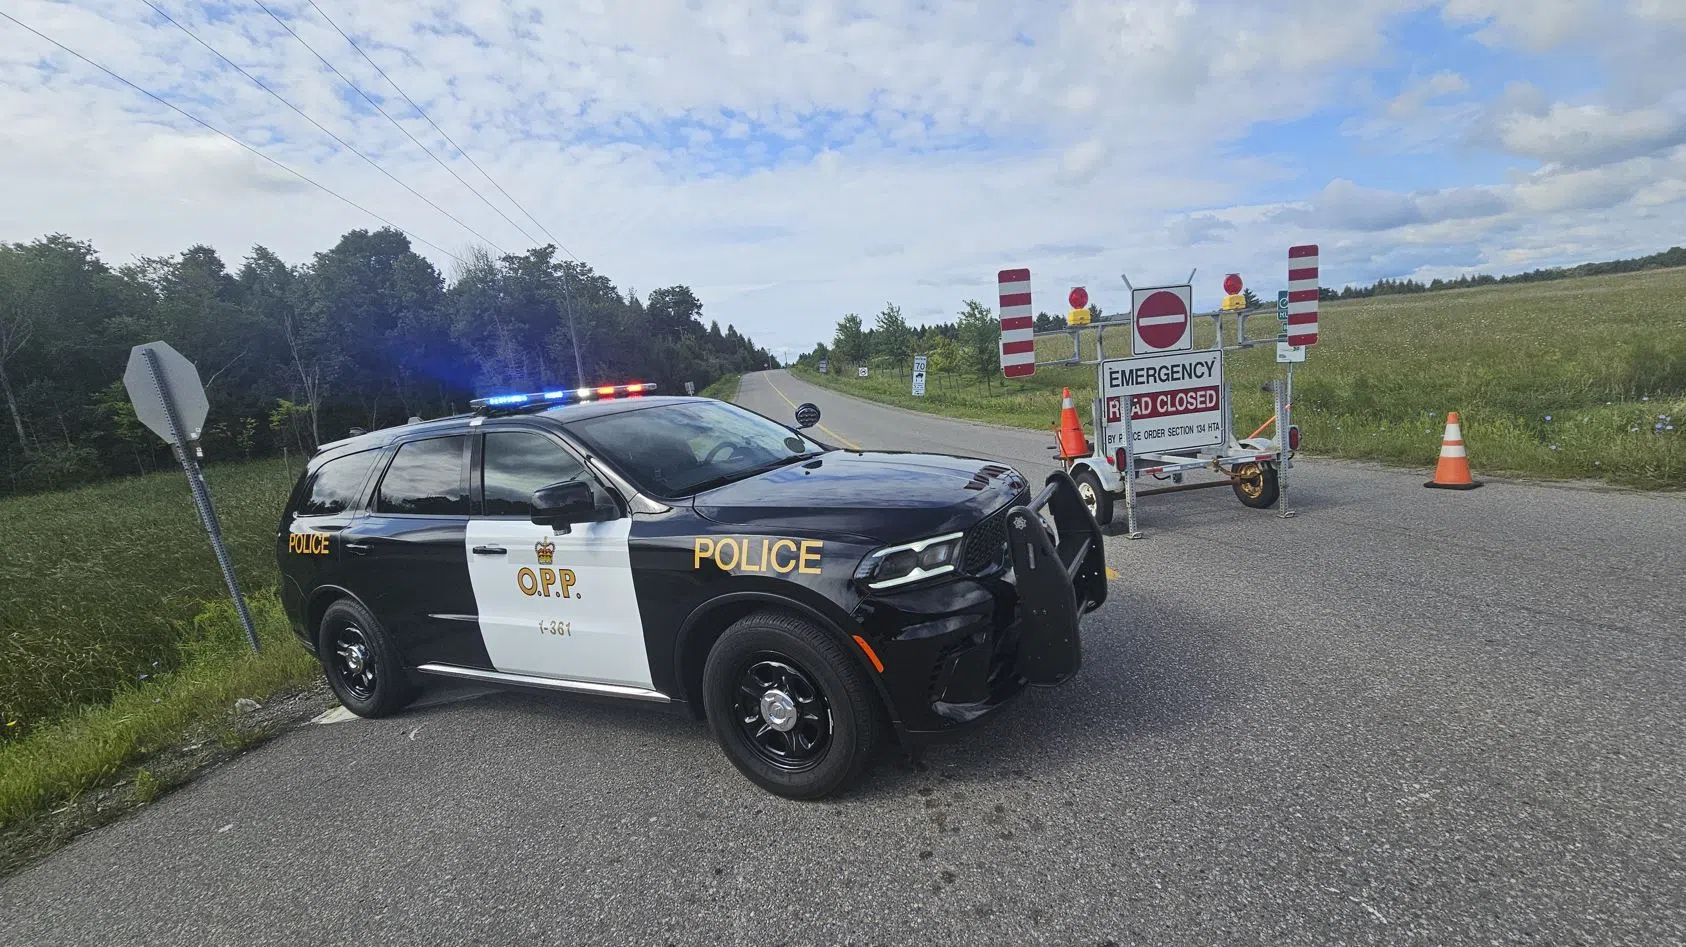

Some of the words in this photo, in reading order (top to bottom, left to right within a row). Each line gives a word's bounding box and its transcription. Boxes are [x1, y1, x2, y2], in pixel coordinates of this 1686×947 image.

[915, 362, 925, 370] 70
[1109, 361, 1215, 388] EMERGENCY
[1109, 396, 1152, 419] RAD
[1156, 390, 1217, 413] CLOSED
[1107, 434, 1116, 444] BY
[1118, 431, 1141, 443] PCE
[1143, 428, 1166, 440] ORDER
[1167, 424, 1195, 437] SECTION
[1196, 422, 1206, 433] 134
[1207, 421, 1220, 432] HTA
[288, 533, 330, 555] POLICE
[694, 537, 824, 575] POLICE
[517, 566, 582, 600] O.P.P.
[539, 619, 571, 637] 1-361
